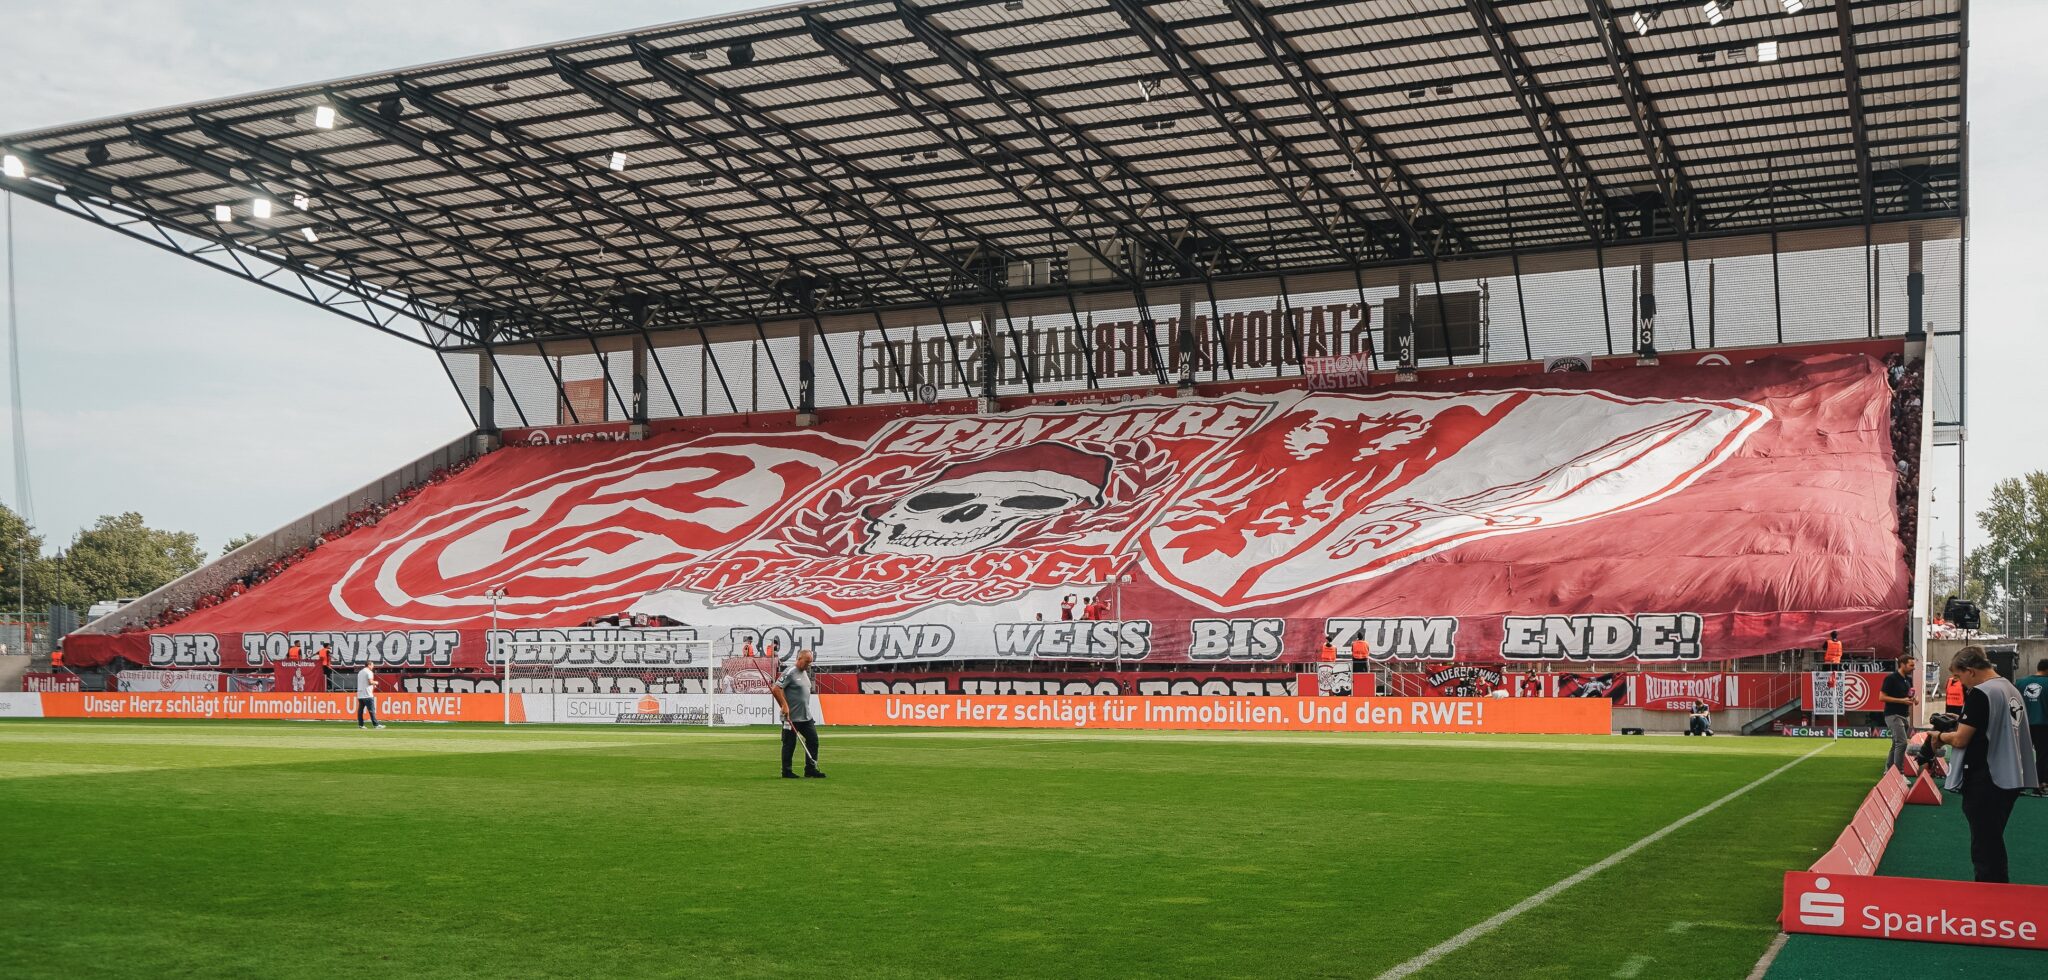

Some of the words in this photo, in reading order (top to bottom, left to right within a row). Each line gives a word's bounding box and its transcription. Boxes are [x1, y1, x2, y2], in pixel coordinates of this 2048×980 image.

[1307, 370, 1369, 390] KASTEN
[885, 416, 1058, 453] ZEHN
[1048, 405, 1261, 443] JAHRE
[902, 577, 1031, 601] 2015
[150, 633, 219, 667] DER
[243, 630, 460, 667] TOTENKOPF
[485, 628, 698, 666] BEDEUTET
[731, 626, 824, 662] ROT
[858, 624, 954, 661] UND
[995, 619, 1152, 660] WEISS
[1189, 617, 1285, 661] BIS
[1325, 615, 1459, 661] ZUM
[1501, 612, 1702, 662] ENDE!
[1645, 673, 1721, 703] RUHRFRONT
[84, 696, 127, 713] Unser
[130, 696, 162, 713] Herz
[166, 695, 219, 717] schlägt
[223, 696, 246, 713] für
[250, 696, 342, 714] Immobilien.
[382, 697, 410, 714] den
[416, 697, 462, 715] RWE!
[570, 701, 632, 717] SCHULTE
[675, 703, 774, 718] Immoblien-Gruppe
[886, 699, 950, 720] Unser
[957, 699, 1007, 721] Herz
[1014, 699, 1098, 727] schlägt
[1101, 699, 1137, 722] für
[1144, 700, 1288, 724] Immobilien.
[1299, 700, 1350, 724] Und
[1355, 700, 1402, 725] den
[1411, 701, 1483, 725] RWE!
[1783, 728, 1824, 736] NEQbet
[1861, 905, 2038, 941] Sparkasse
